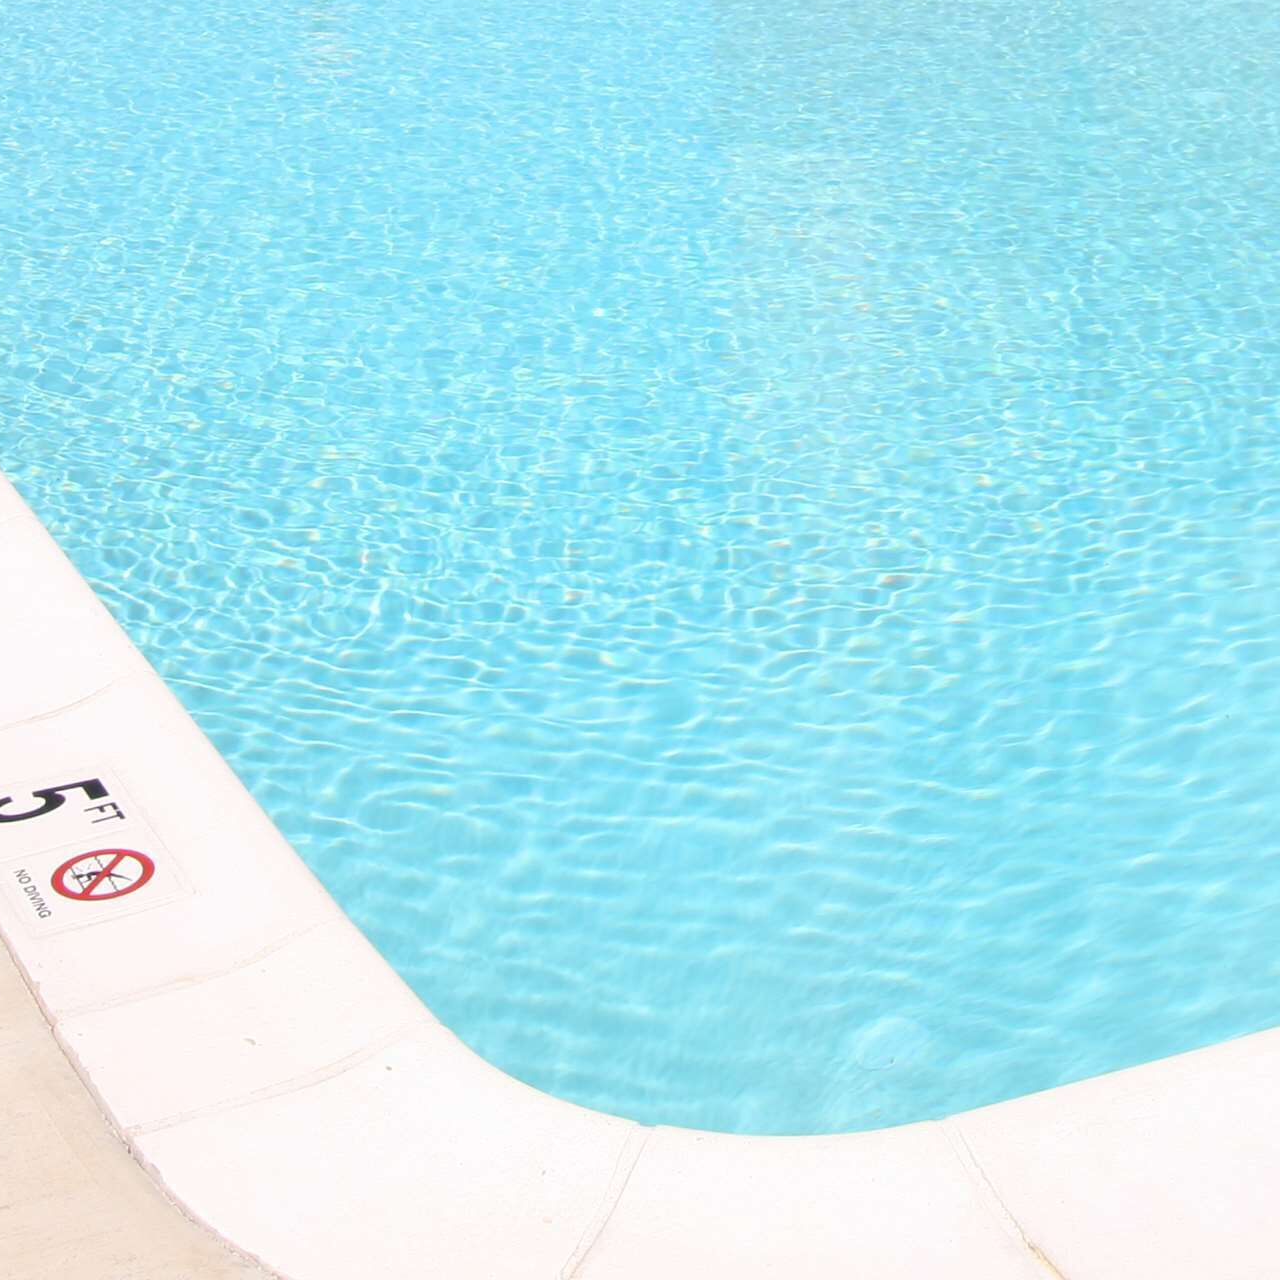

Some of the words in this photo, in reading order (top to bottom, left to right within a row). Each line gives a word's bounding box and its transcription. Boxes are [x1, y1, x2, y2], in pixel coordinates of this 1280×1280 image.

[83, 801, 126, 824] FT
[13, 868, 32, 885] NO
[24, 884, 52, 919] DIVING
